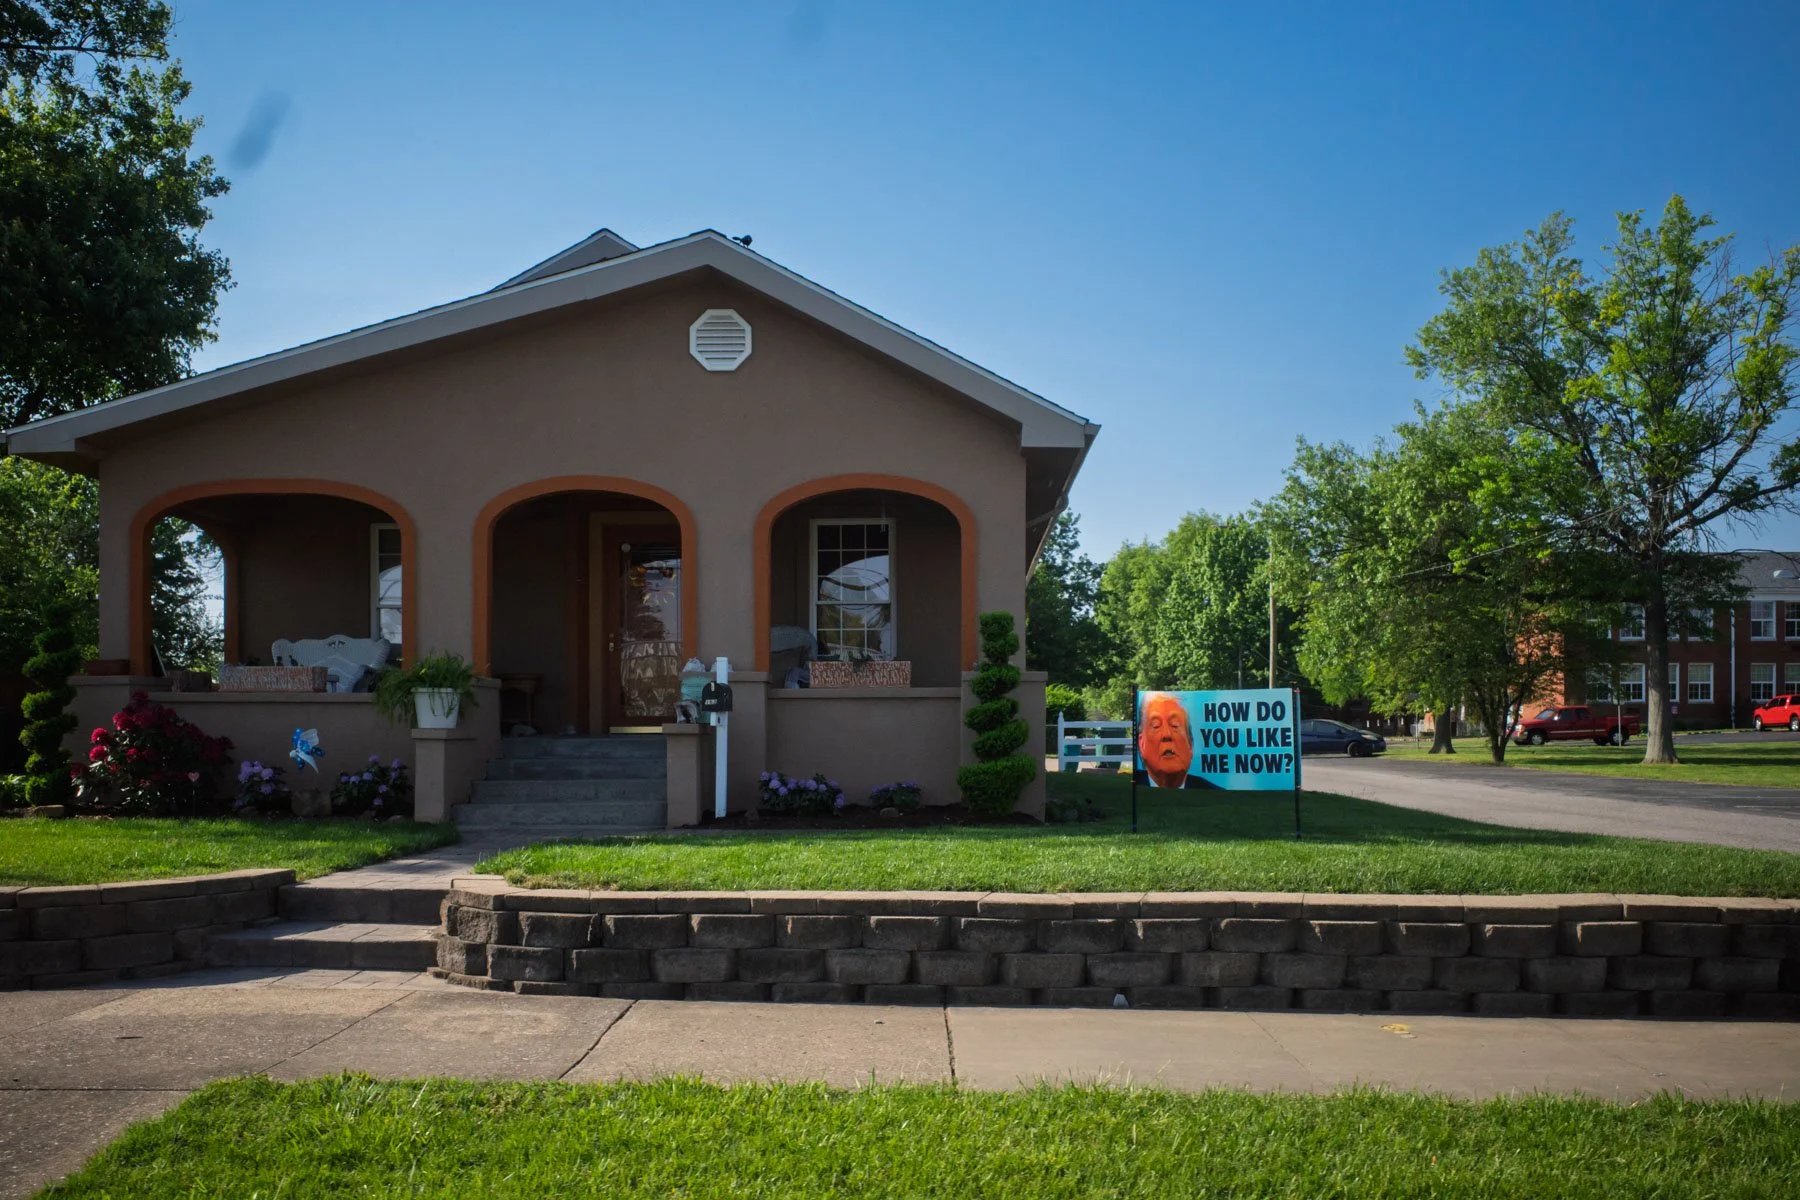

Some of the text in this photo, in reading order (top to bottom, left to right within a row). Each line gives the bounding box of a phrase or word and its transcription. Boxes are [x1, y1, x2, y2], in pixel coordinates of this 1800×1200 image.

[1204, 701, 1286, 722] HOW DO
[1200, 727, 1292, 748] YOU LIKE
[1201, 753, 1294, 774] ME NOW?
